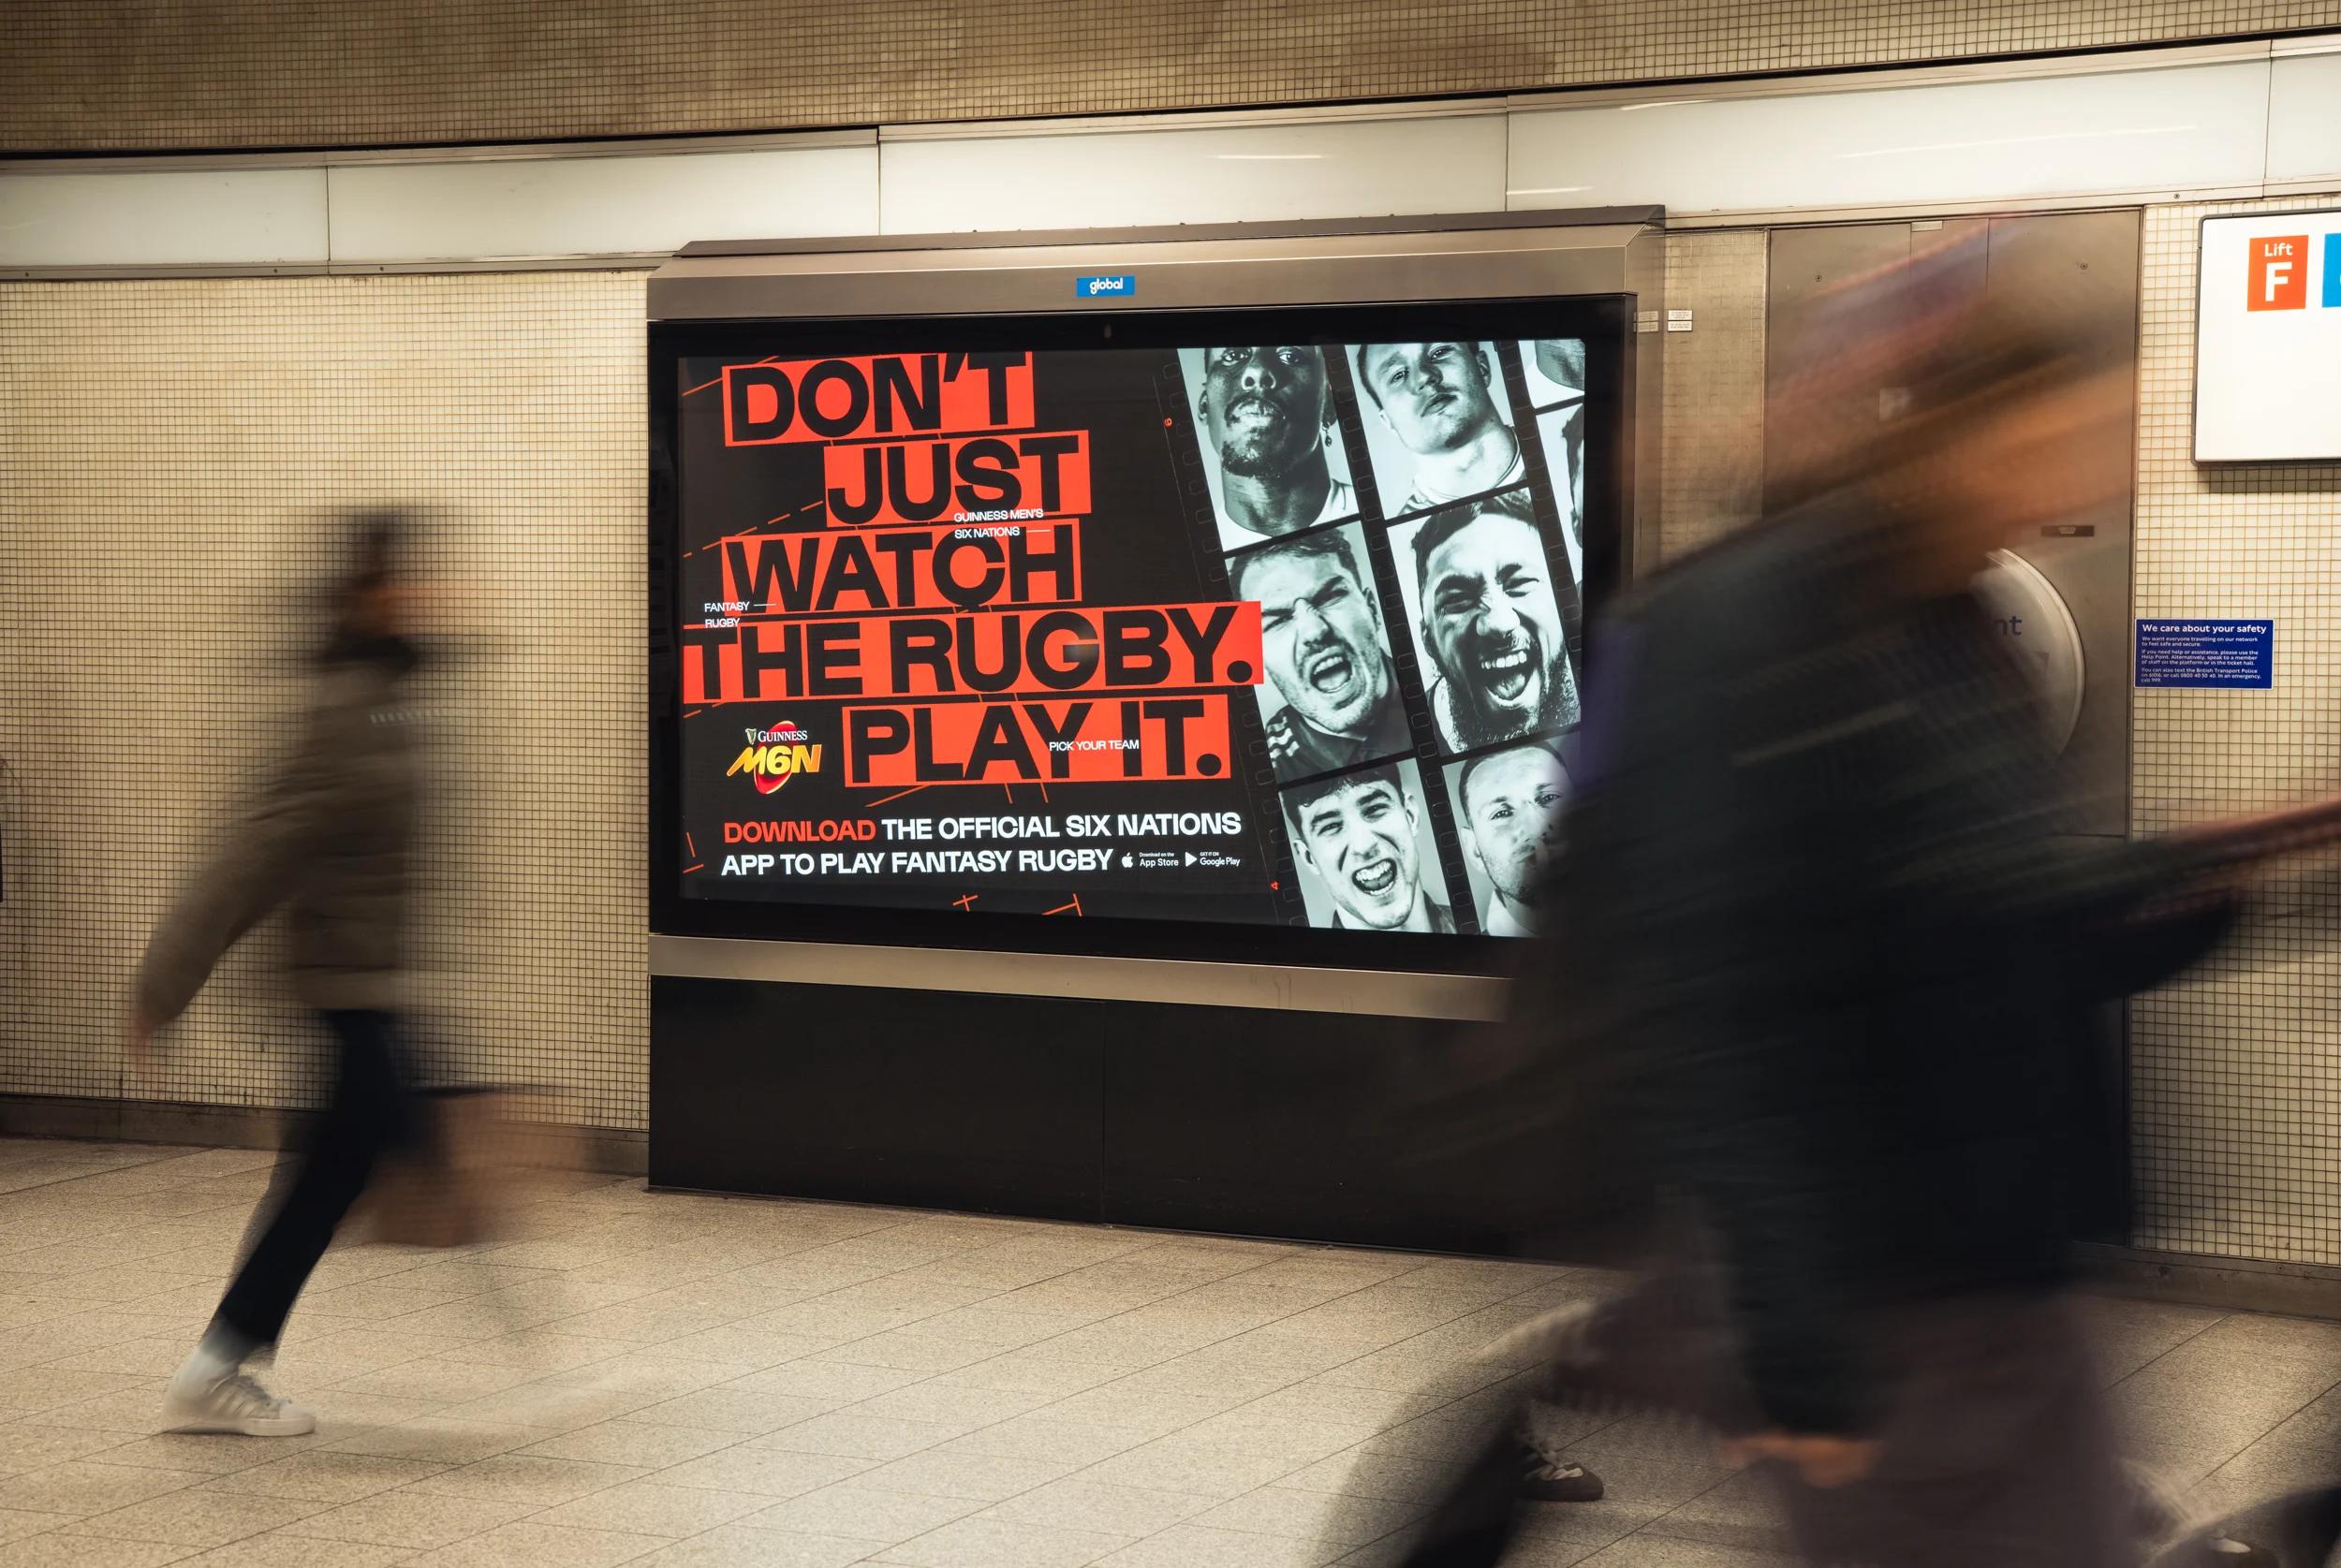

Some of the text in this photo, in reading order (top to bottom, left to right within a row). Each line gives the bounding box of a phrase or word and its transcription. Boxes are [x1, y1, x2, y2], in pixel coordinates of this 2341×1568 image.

[2264, 242, 2293, 257] Lift
[1089, 277, 1124, 295] global
[2265, 261, 2292, 301] F
[729, 352, 1027, 443] DON'T
[827, 434, 1080, 525] JUST
[953, 507, 1044, 523] GUINNESS MEN'S
[954, 526, 1021, 539] SIX NATIONS
[726, 523, 1075, 613] WATCH
[704, 601, 750, 612] FANTASY
[704, 618, 740, 628] RUGBY
[2236, 624, 2267, 635] safety
[684, 605, 1253, 701] THE RUGBY.
[758, 730, 808, 742] GUINNESS
[849, 698, 1222, 784] PLAY IT.
[1049, 739, 1140, 752] PICK YOUR TEAM
[724, 812, 1242, 843] DOWNLOAD THE OFFICIAL SIX NATIONS
[721, 848, 1114, 876] APP TO PLAY FANTASY RUGBY
[1140, 858, 1179, 868] App Store
[1200, 857, 1241, 867] Google Play
